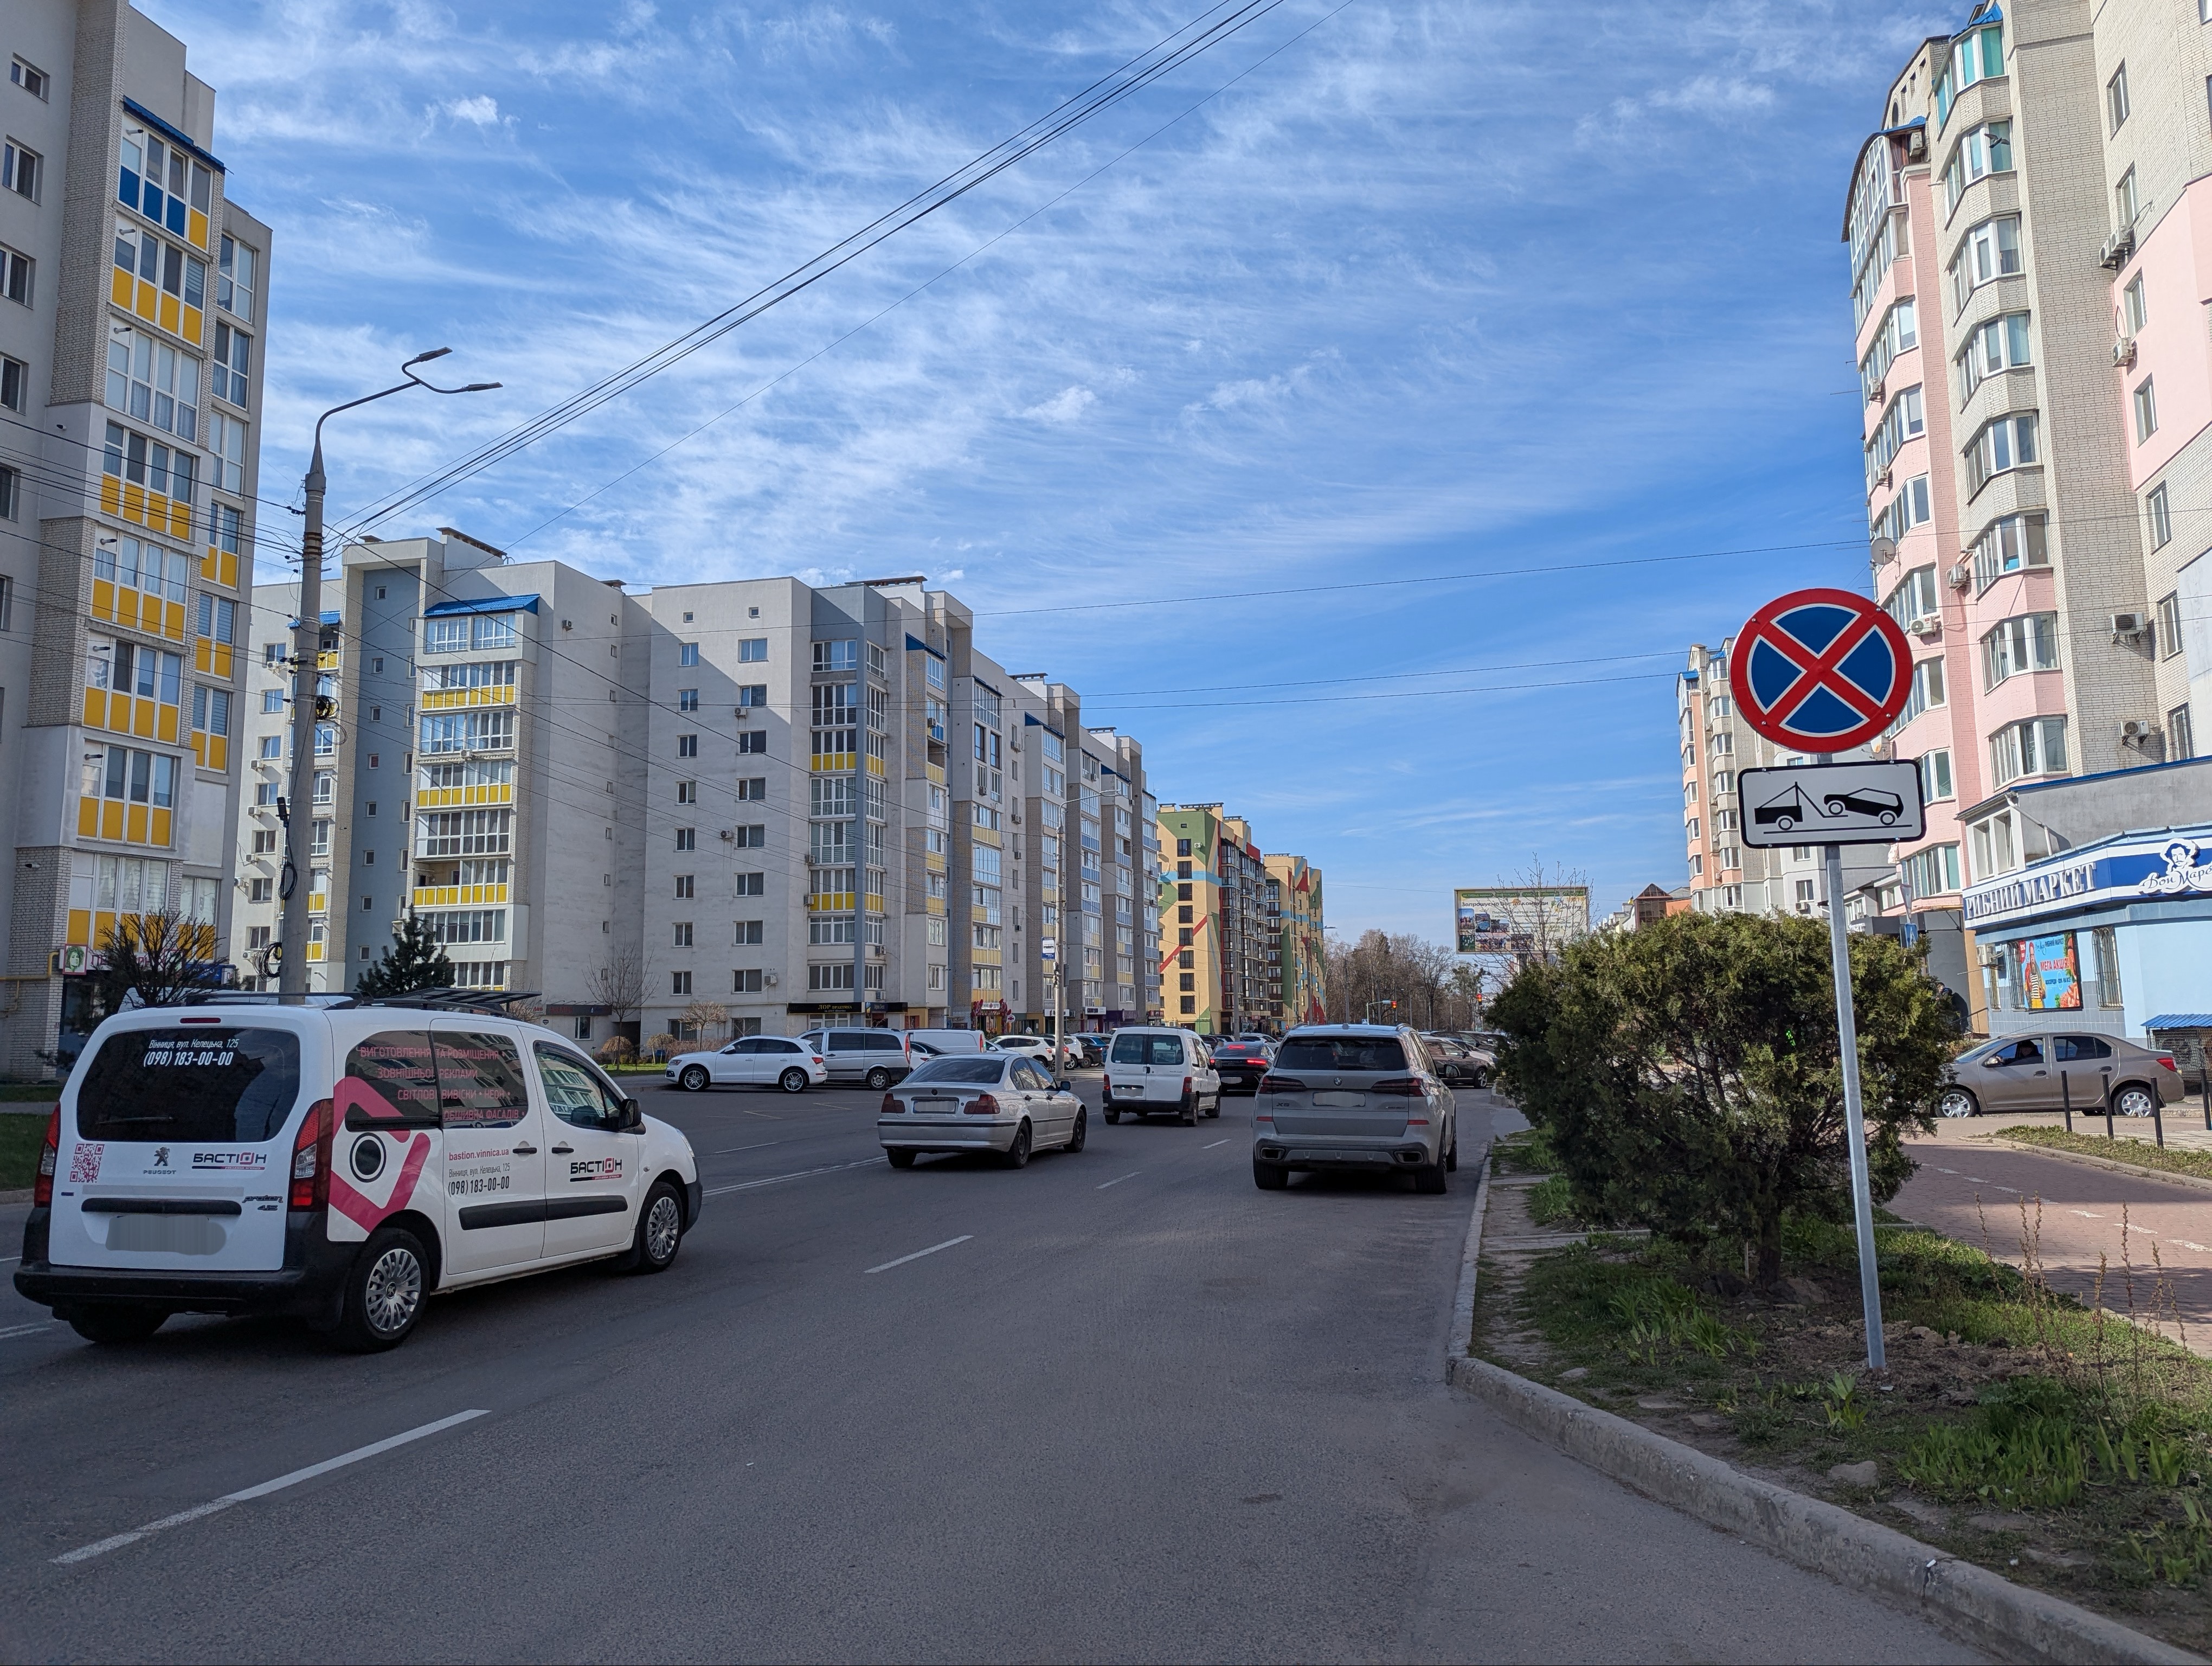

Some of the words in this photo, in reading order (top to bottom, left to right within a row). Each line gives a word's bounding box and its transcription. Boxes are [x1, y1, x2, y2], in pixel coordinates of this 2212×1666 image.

[1965, 883, 2023, 919] РИБНИЙ
[2023, 862, 2097, 905] МАРКЕТ
[2040, 960, 2053, 972] МЕГА
[149, 1040, 175, 1049] Вінниця,
[176, 1041, 189, 1050] вул.
[191, 1039, 223, 1049] Келецька,
[226, 1039, 240, 1048] 125
[143, 1051, 172, 1067] (098)
[174, 1052, 234, 1066] 183-00-00
[359, 1047, 432, 1058] ВИГОТОВЛЕННЯ
[434, 1048, 446, 1058] ТА
[448, 1049, 499, 1061] РОЗМІЩЕННЯ
[439, 1068, 478, 1079] РЕКЛАМИ
[397, 1089, 437, 1100] СВІТЛОВІ
[441, 1090, 477, 1100] ВИВІСКИ
[485, 1090, 504, 1100] НЕОН
[486, 1109, 519, 1120] ФАСАДІВ
[193, 1152, 267, 1164] БАСТІОН
[449, 1149, 510, 1161] bastion.vinnica.ua
[449, 1169, 468, 1178] Вінниця,
[470, 1168, 479, 1177] вул.
[480, 1165, 501, 1174] Келецька,
[570, 1157, 622, 1175] БАСТІОН
[448, 1180, 468, 1197] (098)
[470, 1176, 510, 1193] 183-00-00
